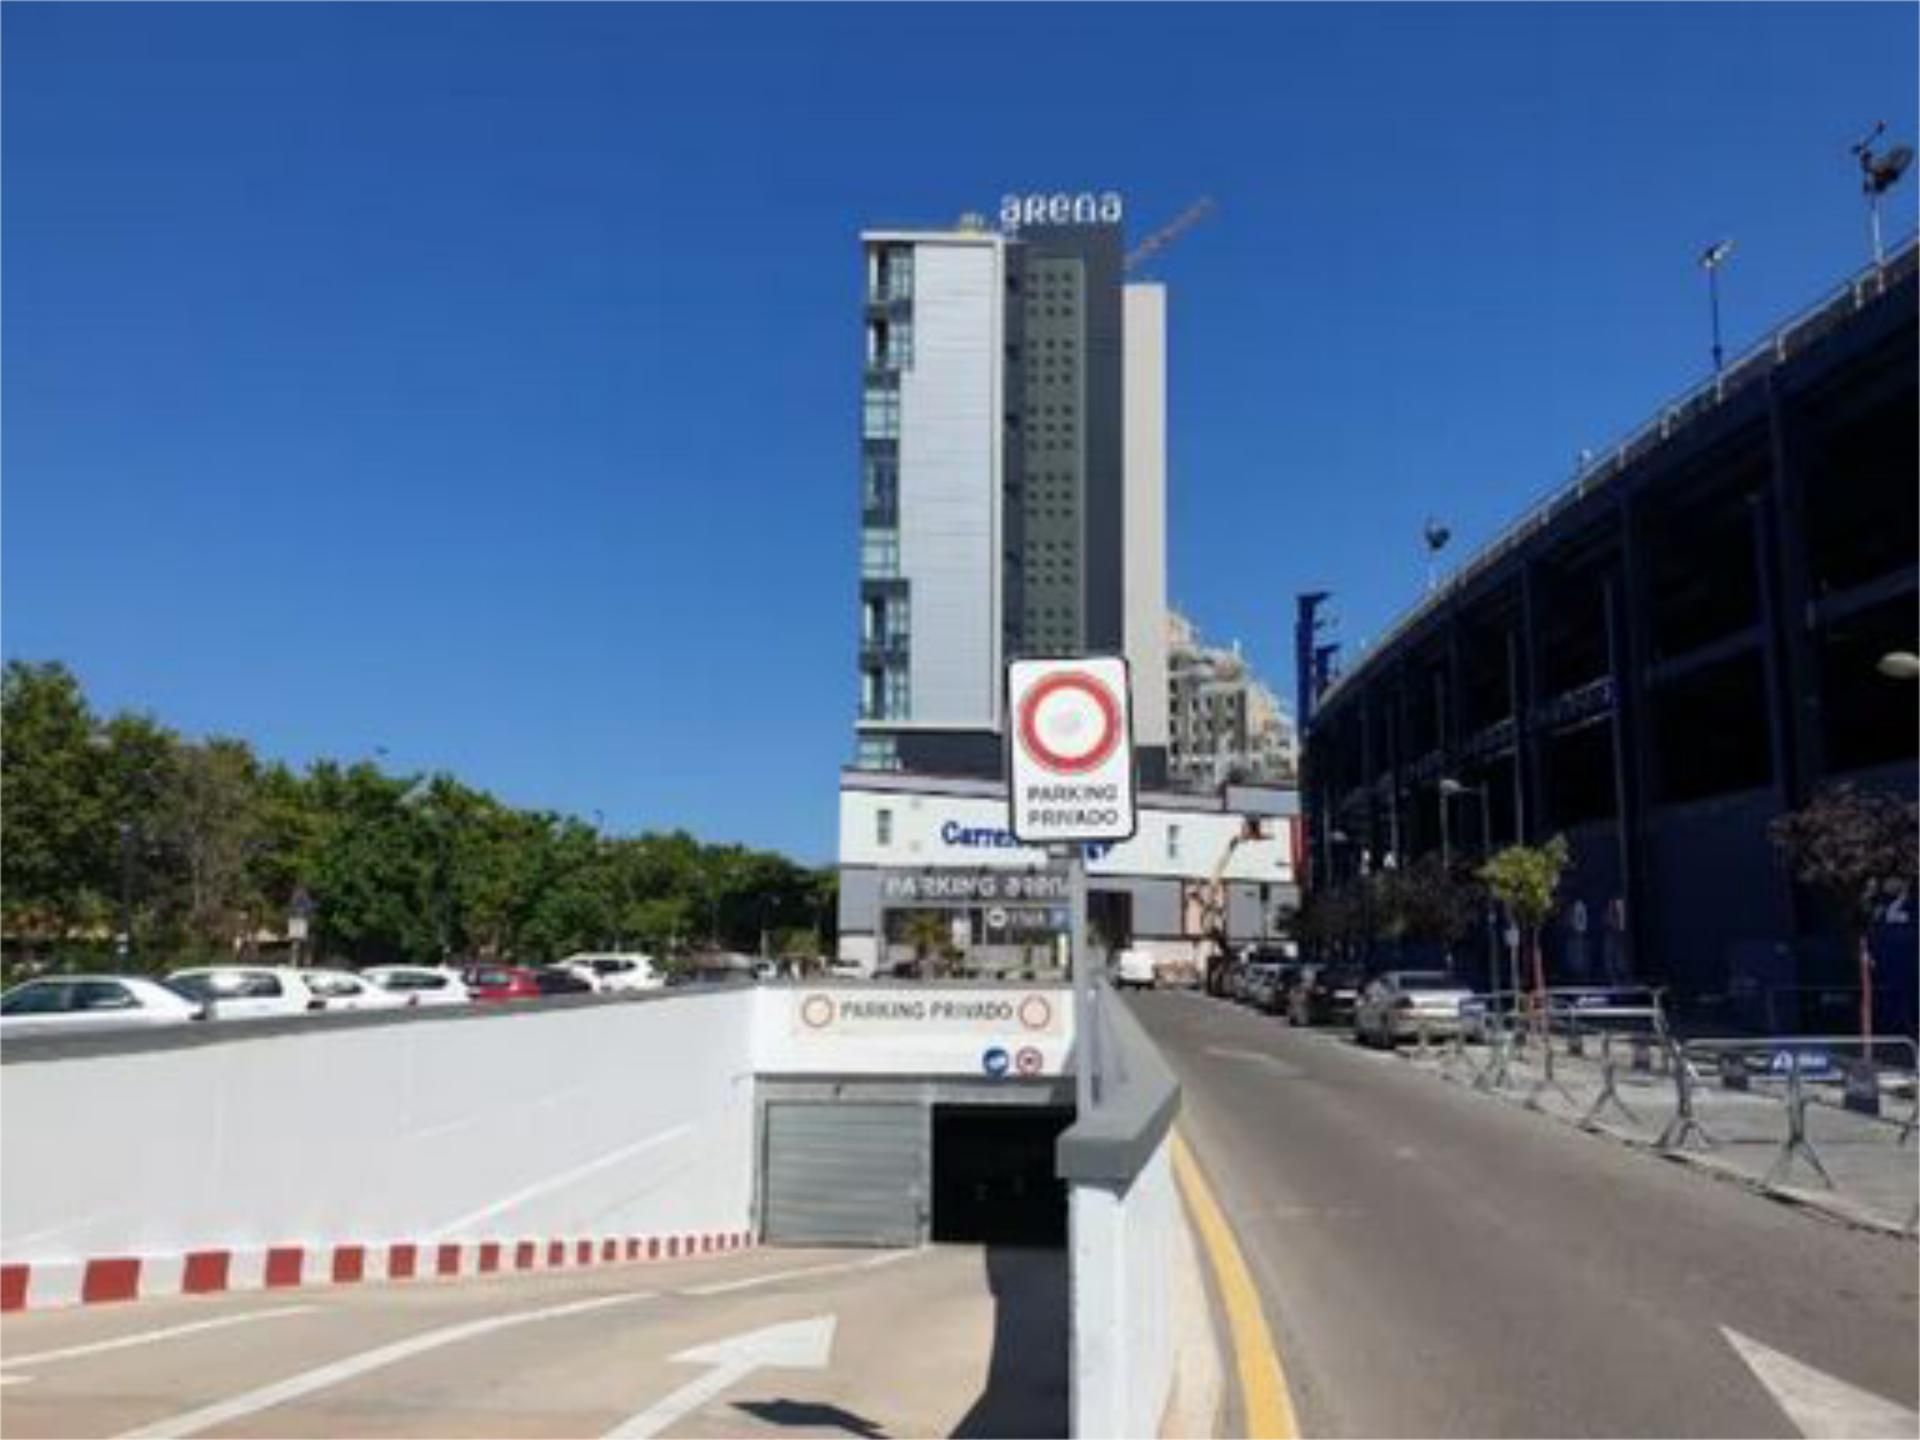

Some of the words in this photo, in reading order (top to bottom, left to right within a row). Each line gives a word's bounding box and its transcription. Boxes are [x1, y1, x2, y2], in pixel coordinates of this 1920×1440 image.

[1027, 785, 1118, 802] PARKING
[1028, 809, 1119, 826] PRIVADO
[884, 876, 995, 897] PARKING
[840, 1001, 925, 1020] PARKING
[930, 1001, 1014, 1020] PRIVADO
